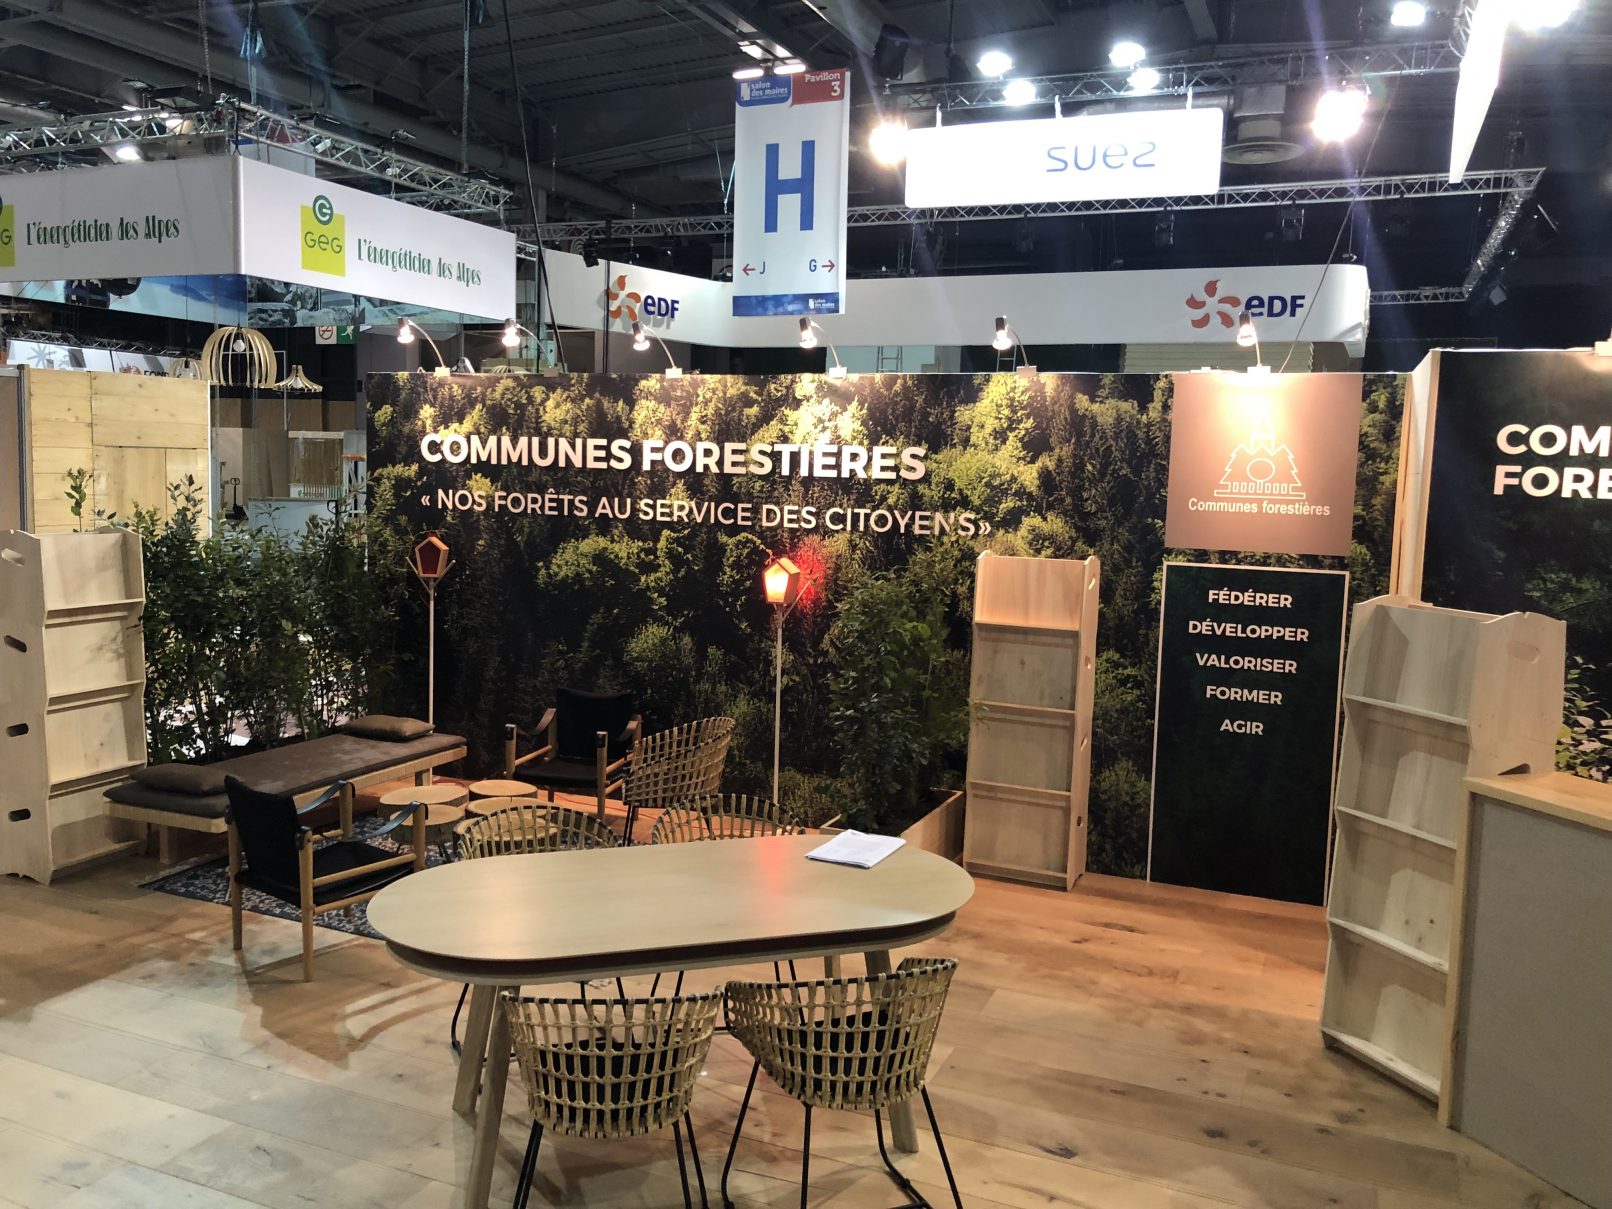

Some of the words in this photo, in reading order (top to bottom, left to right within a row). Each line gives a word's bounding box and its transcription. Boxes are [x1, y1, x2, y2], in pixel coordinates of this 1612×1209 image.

[751, 81, 771, 89] salon
[805, 72, 841, 82] Pavillon
[751, 89, 763, 97] des
[764, 87, 788, 96] maires
[831, 81, 841, 97] 3
[764, 140, 815, 233] H
[117, 216, 139, 241] des
[143, 214, 180, 244] Alpes
[436, 257, 453, 279] des
[456, 261, 482, 287] Alpes
[759, 261, 766, 275] J
[809, 258, 817, 272] G
[1496, 423, 1612, 457] COM
[420, 433, 632, 470] COMMUNES
[437, 488, 487, 512] NOS
[494, 488, 588, 517] FORÊTS
[595, 496, 632, 520] AU
[638, 498, 753, 526] SERVICE
[762, 504, 817, 530] DES
[1188, 497, 1258, 513] Communes
[1262, 500, 1331, 516] forestières
[1208, 587, 1293, 608] FÉDÉRER
[1188, 618, 1310, 642] DÉVELOPPER
[1195, 652, 1298, 674] VALORISER
[1205, 685, 1283, 705] FORMER
[1219, 718, 1264, 736] AGIR
